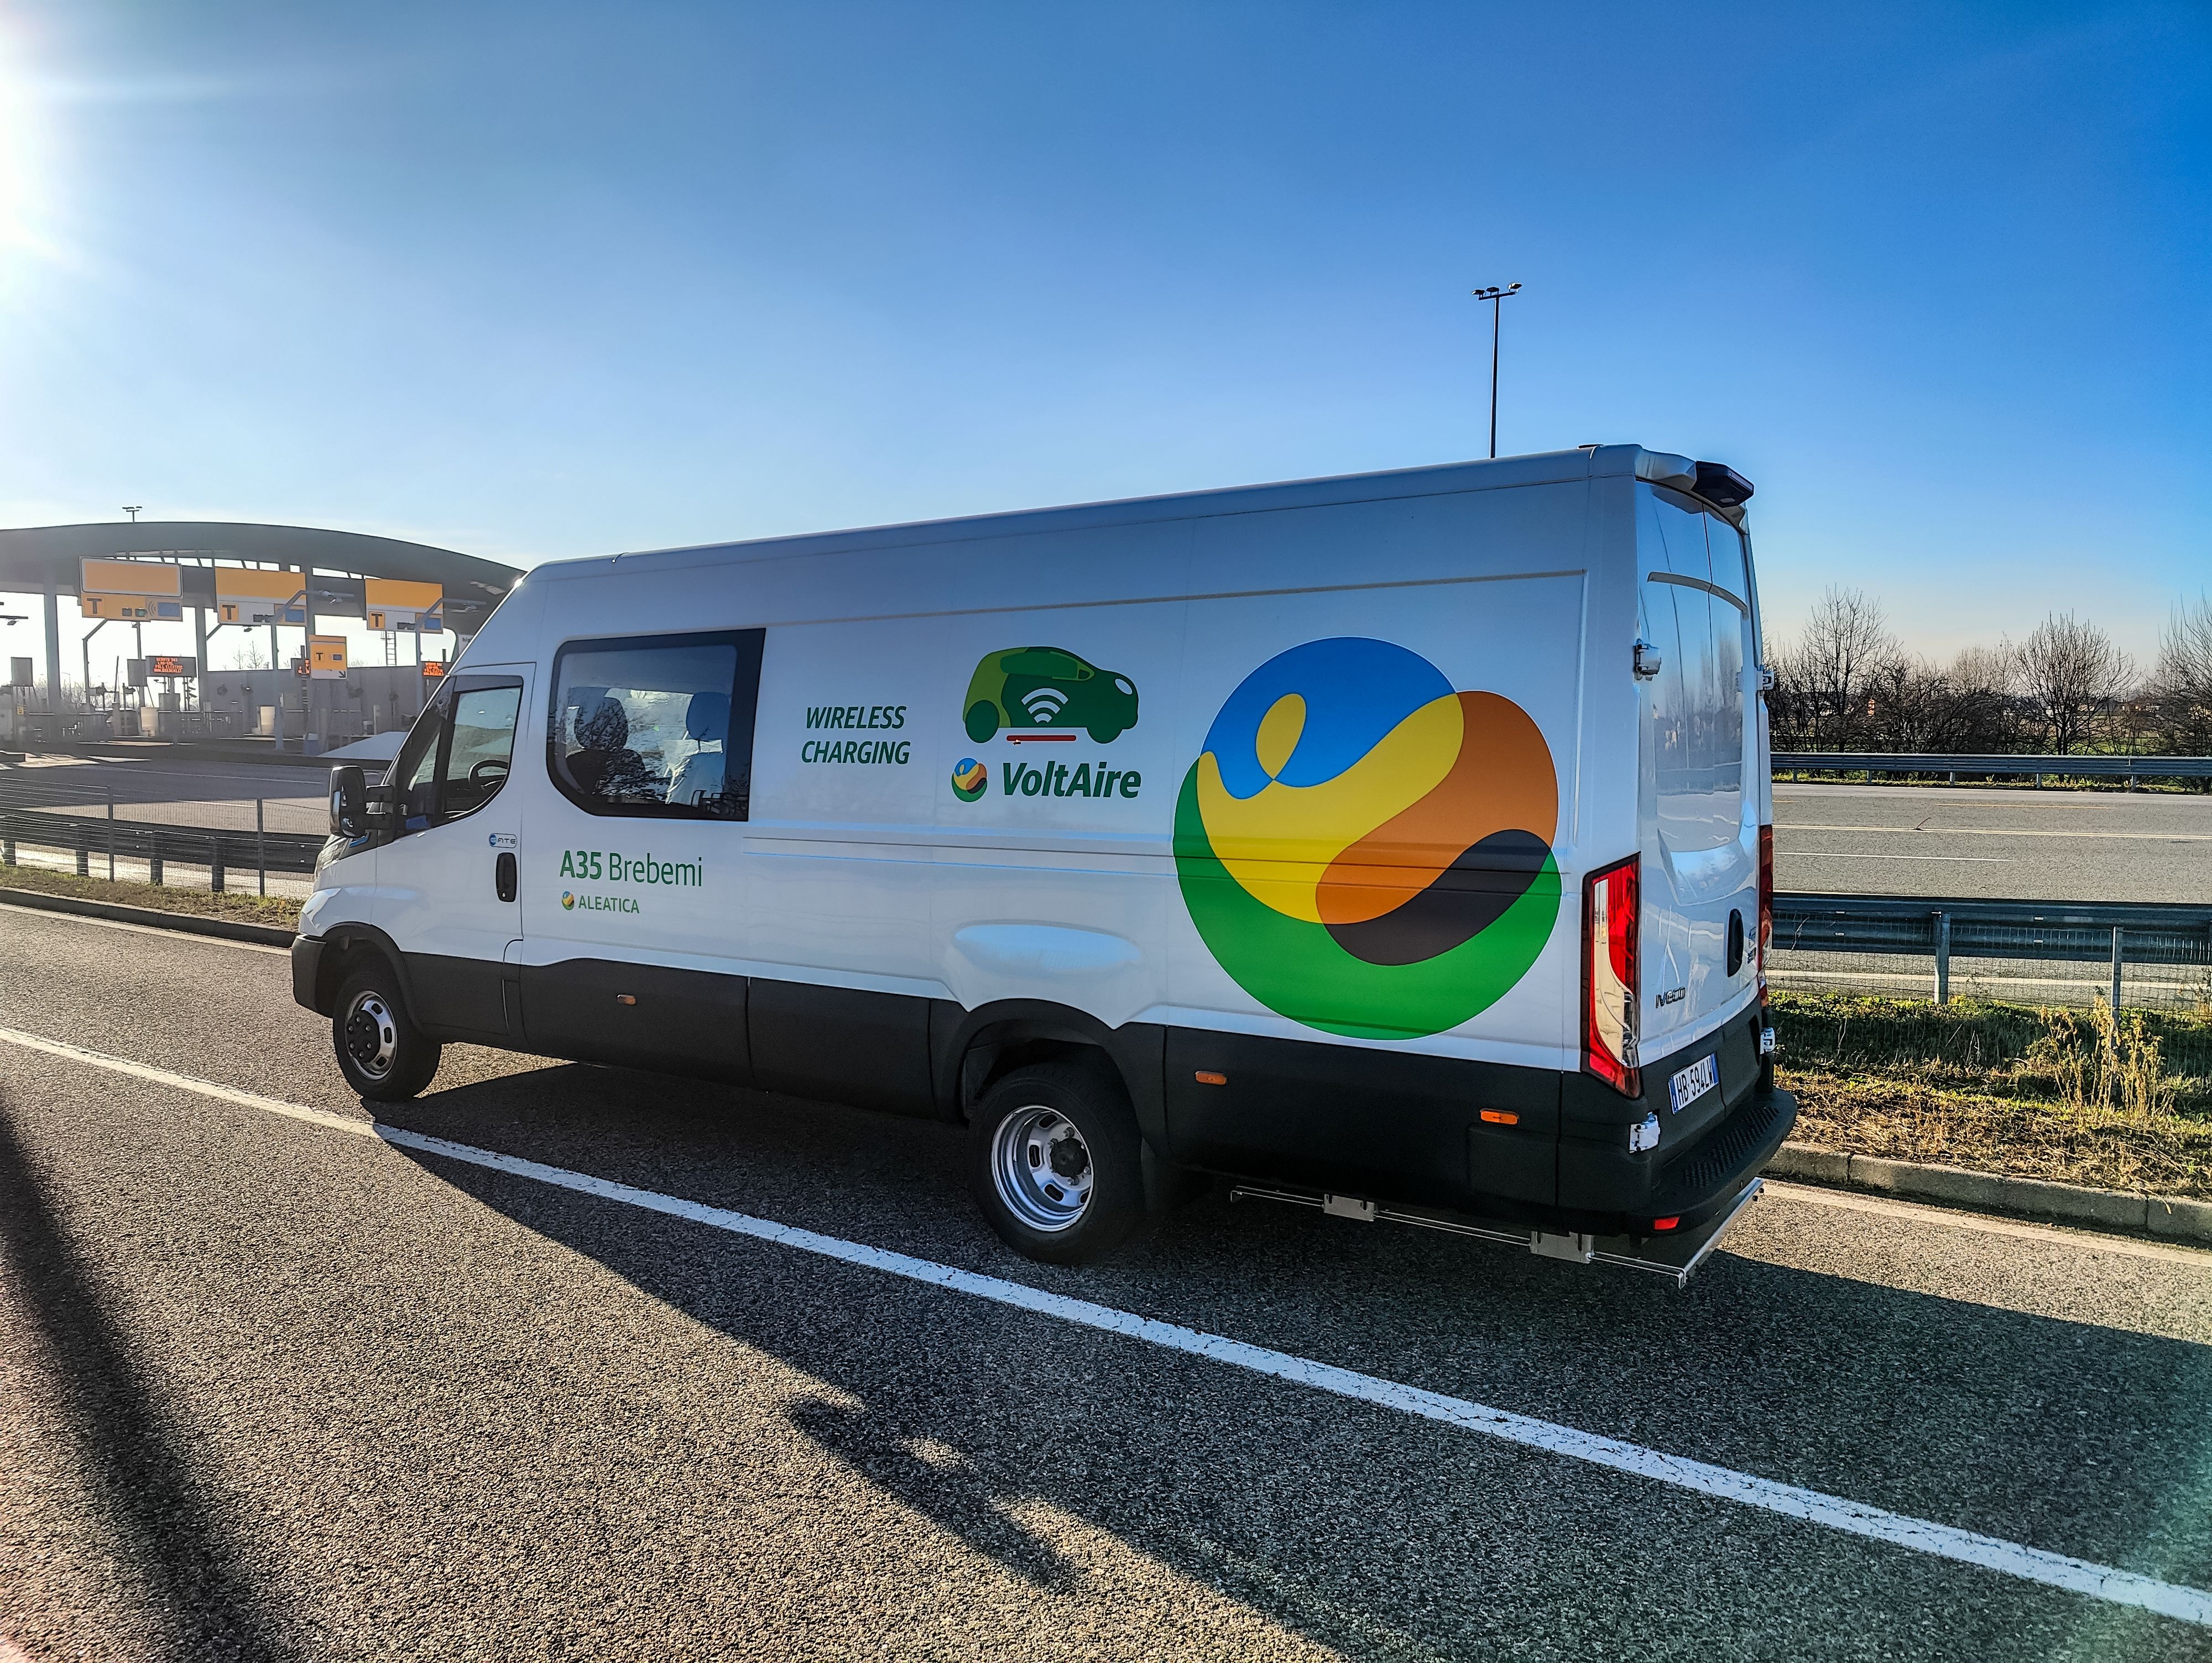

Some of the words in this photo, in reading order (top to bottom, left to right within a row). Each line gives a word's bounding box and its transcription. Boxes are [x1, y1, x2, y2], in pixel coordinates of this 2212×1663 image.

[87, 598, 102, 614] T
[222, 604, 236, 620] T
[371, 613, 383, 627] T
[316, 652, 323, 661] T
[806, 705, 907, 729] WIRELESS
[801, 740, 911, 765] CHARGING
[1002, 761, 1141, 799] VoltAire
[560, 850, 602, 880] A35
[609, 853, 702, 887] Brebemi
[578, 895, 640, 914] ALEATICA
[1655, 986, 1686, 1009] IVECO
[1676, 1074, 1689, 1106] HB
